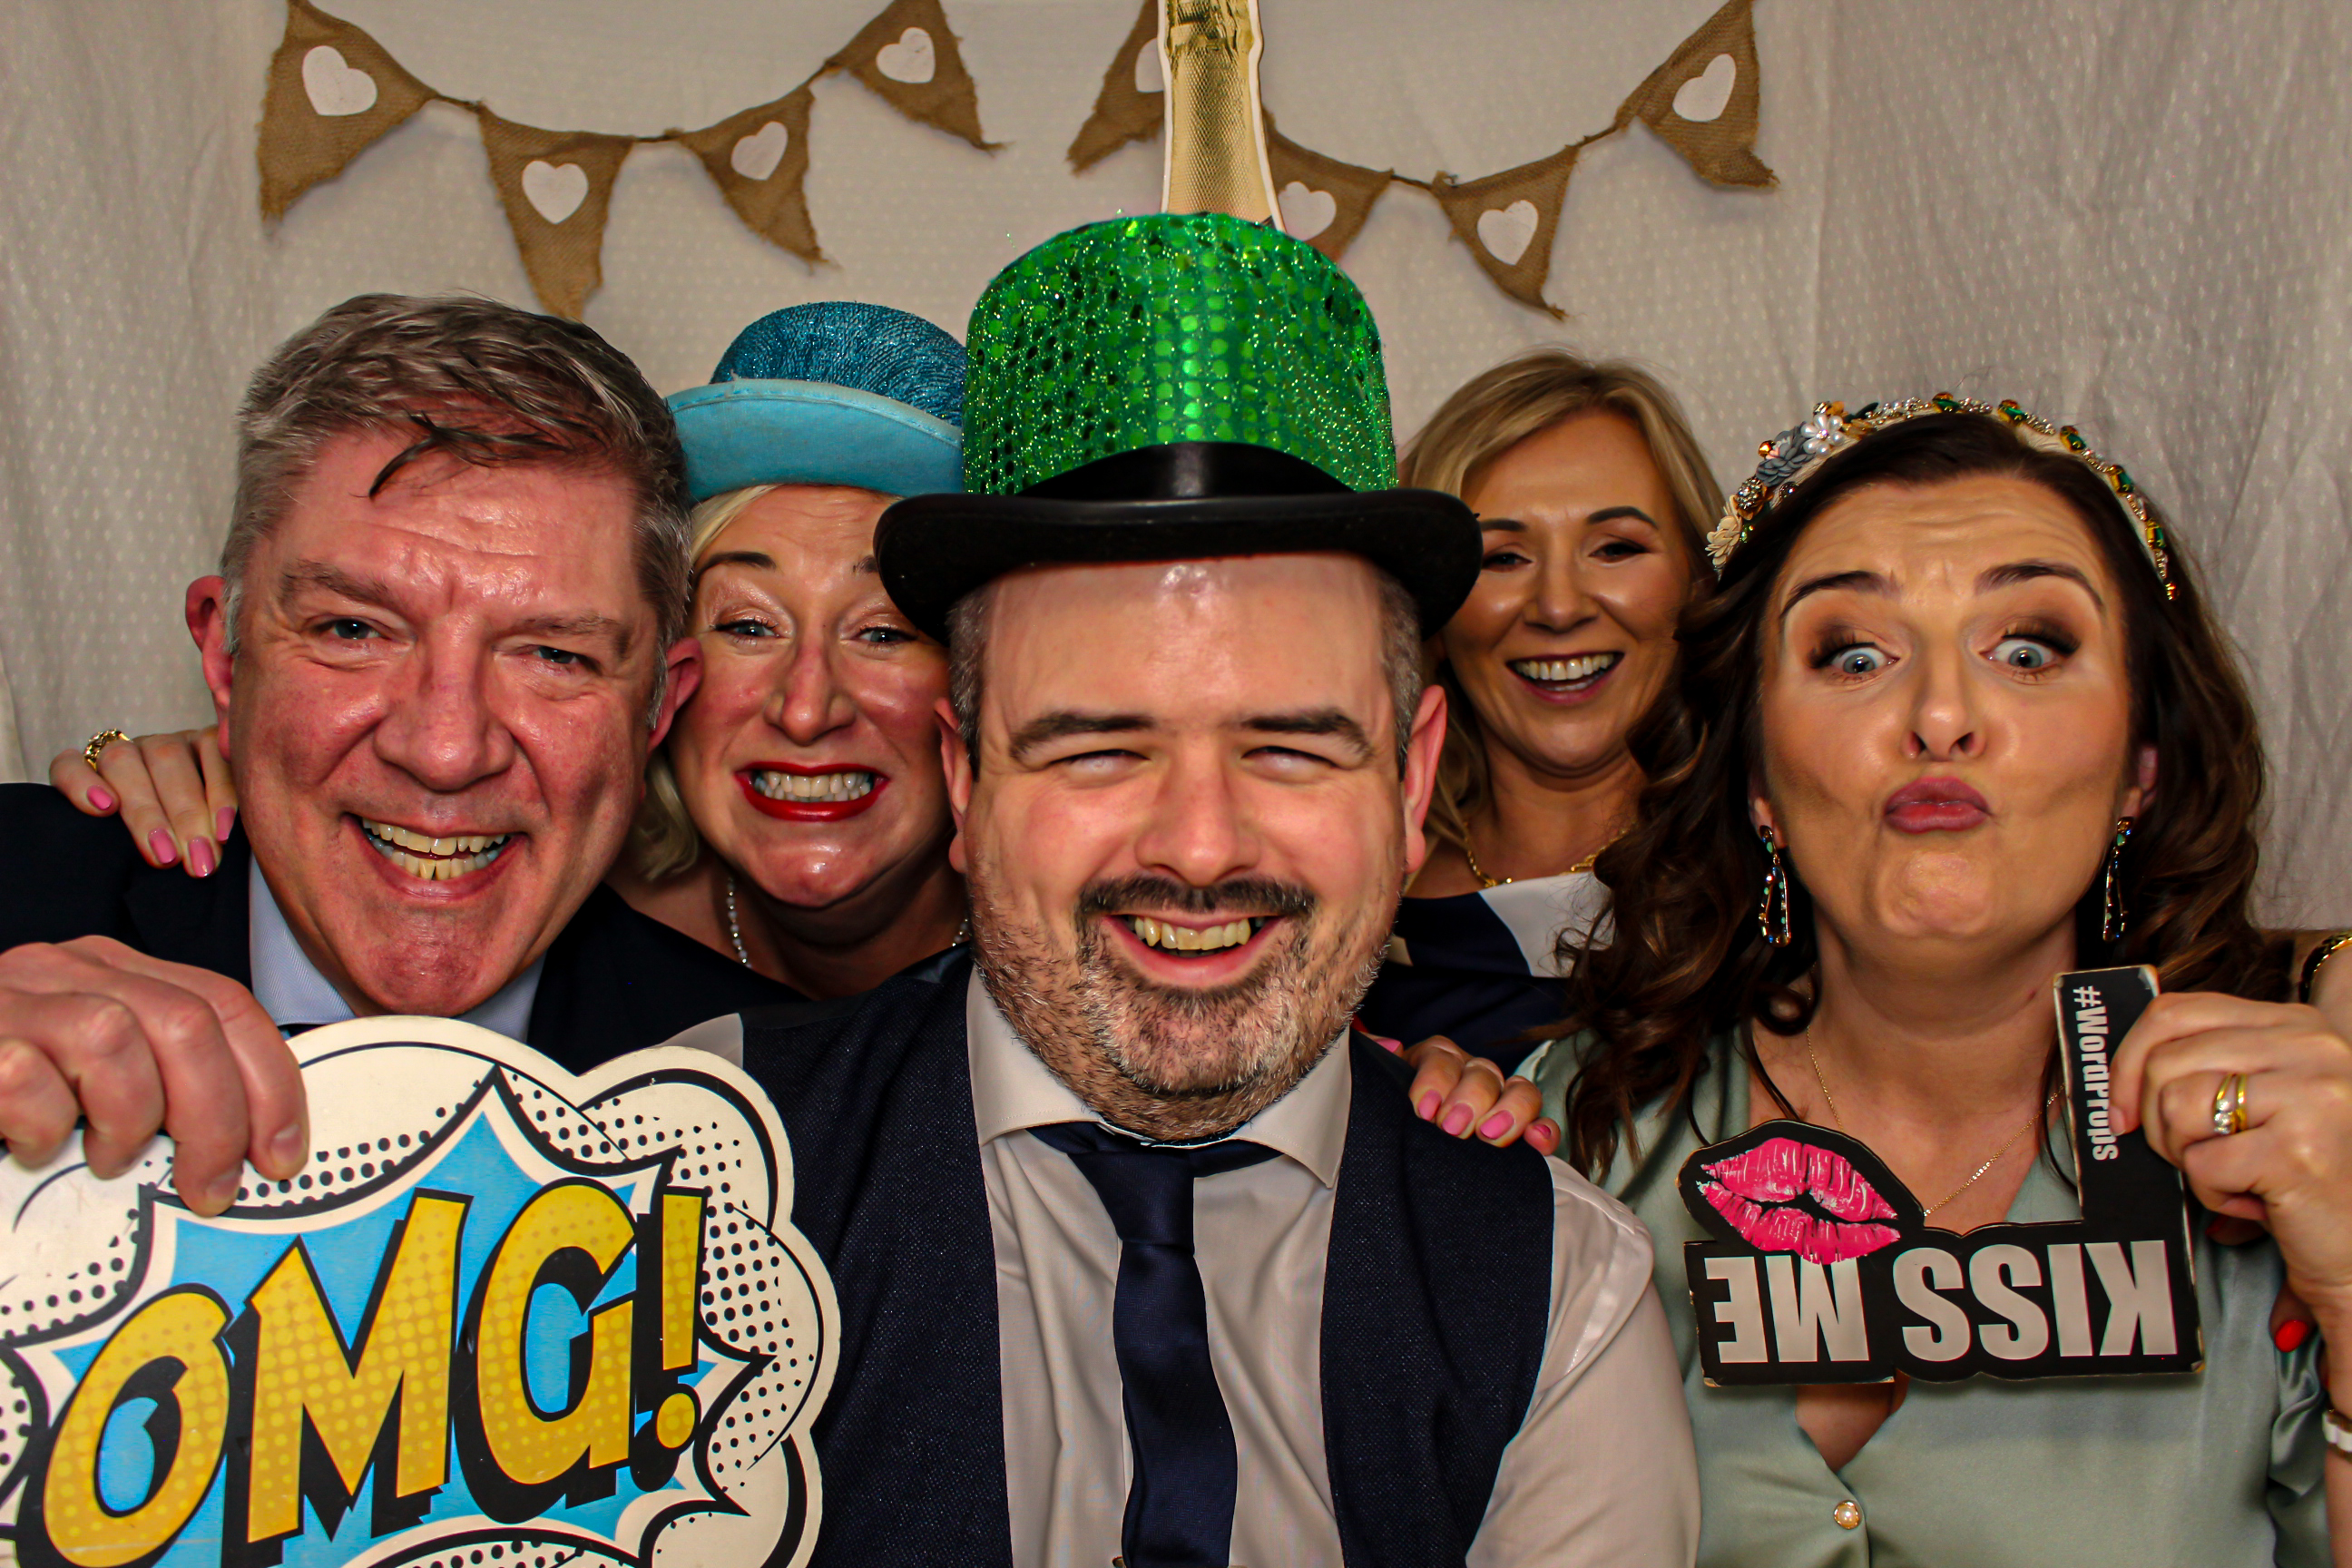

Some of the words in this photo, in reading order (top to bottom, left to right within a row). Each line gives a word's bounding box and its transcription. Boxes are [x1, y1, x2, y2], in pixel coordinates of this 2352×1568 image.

[2073, 985, 2119, 1161] #WordProps
[38, 1177, 707, 1568] OMG!
[1704, 1254, 1870, 1363] ME
[1892, 1240, 2177, 1362] KISS
